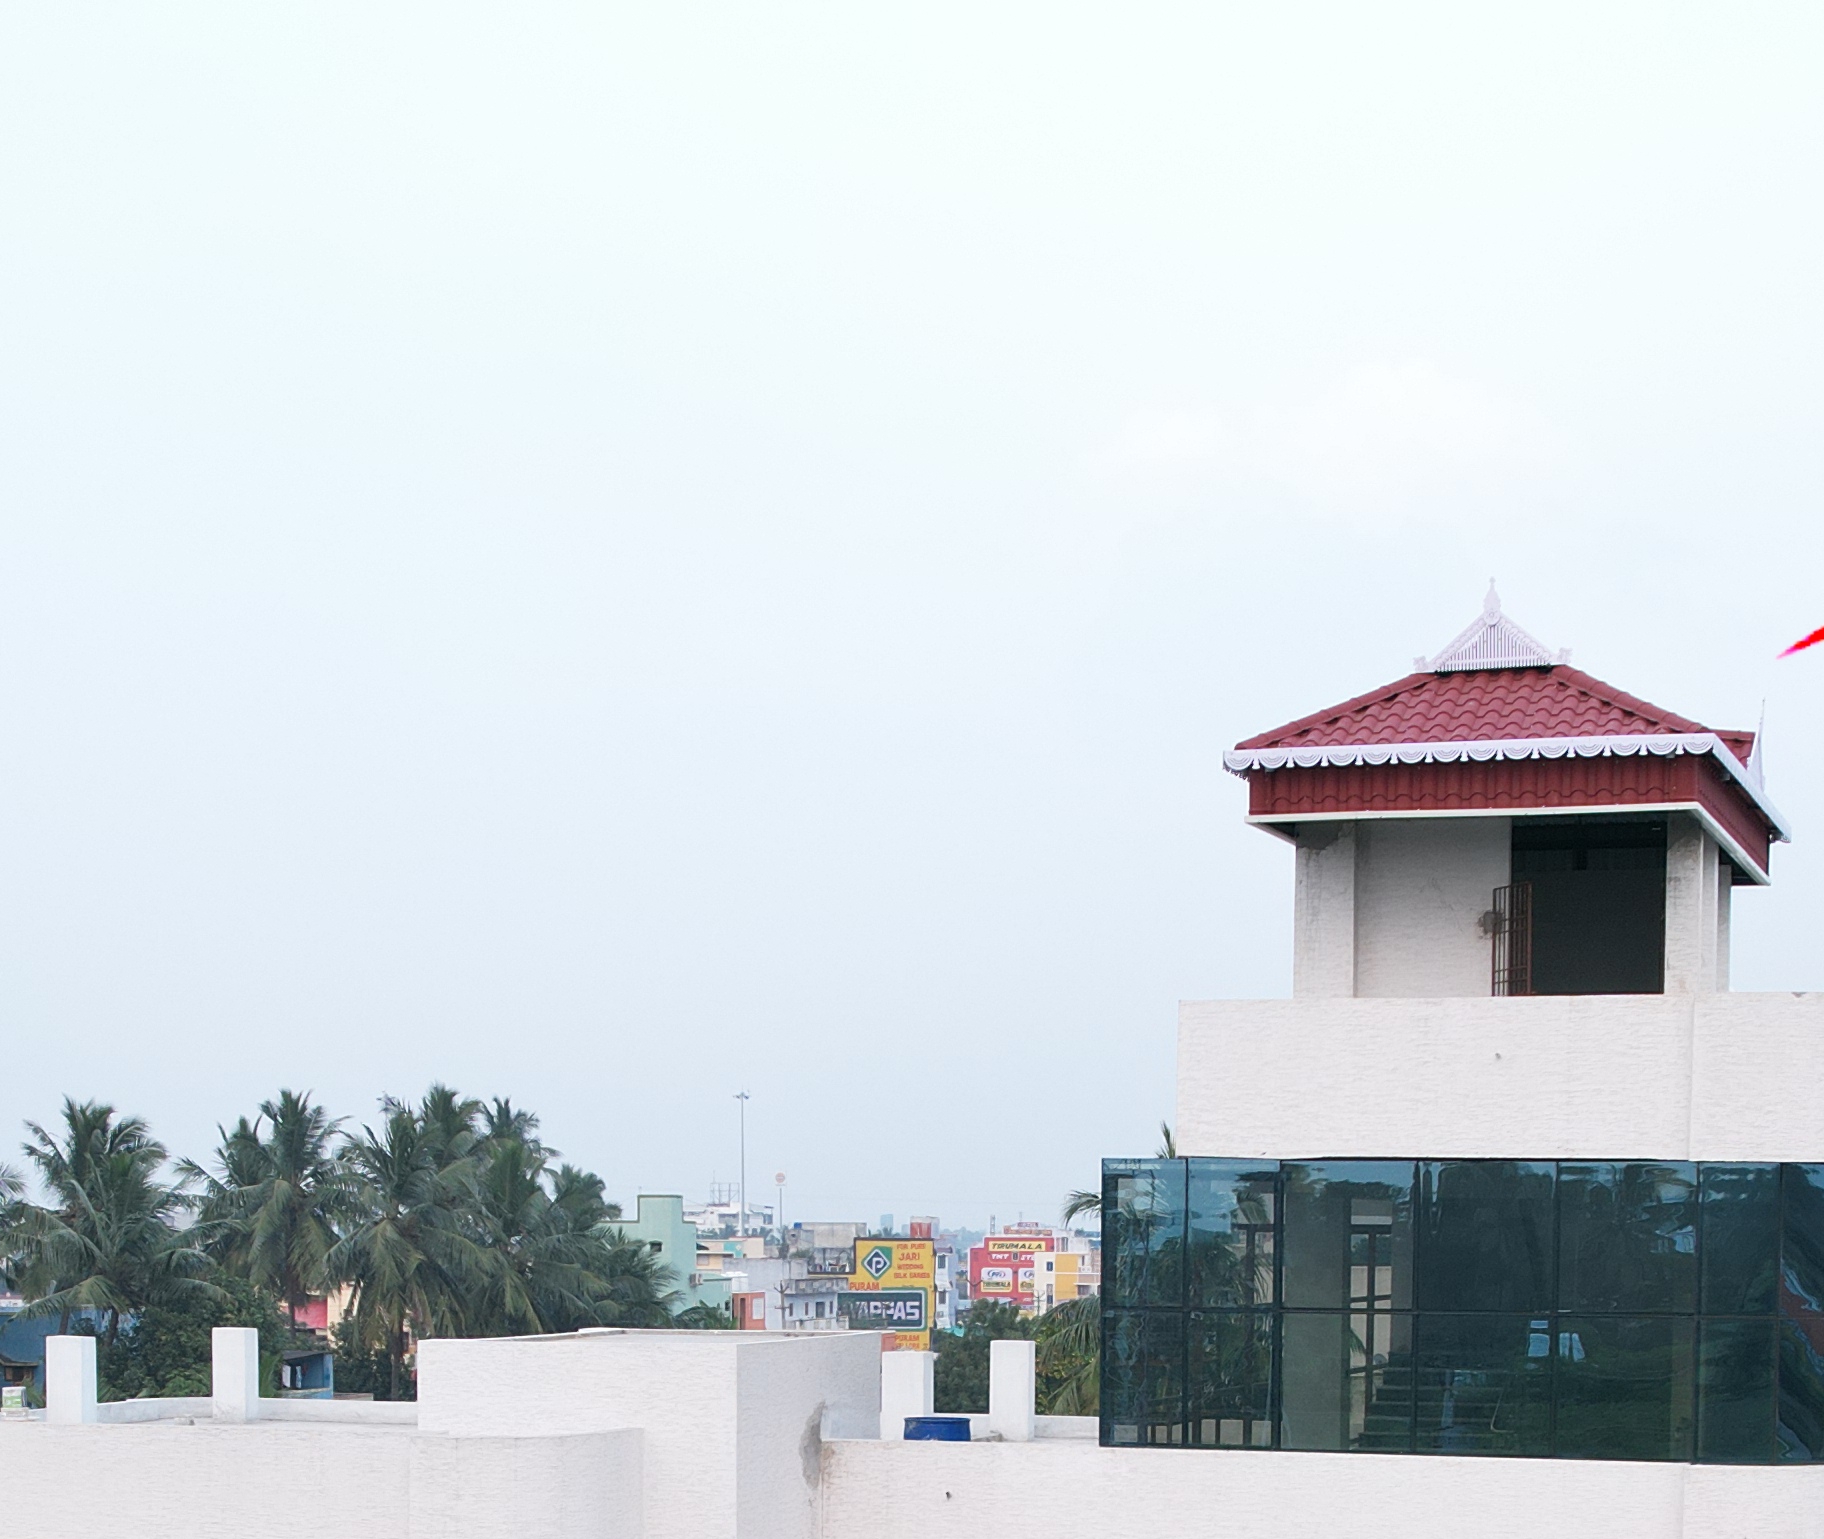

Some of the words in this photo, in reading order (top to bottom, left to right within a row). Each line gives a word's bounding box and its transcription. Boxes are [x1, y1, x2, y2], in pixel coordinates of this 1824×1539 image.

[899, 1252, 920, 1260] JARI
[871, 1257, 884, 1274] P
[849, 1282, 880, 1291] PURAM
